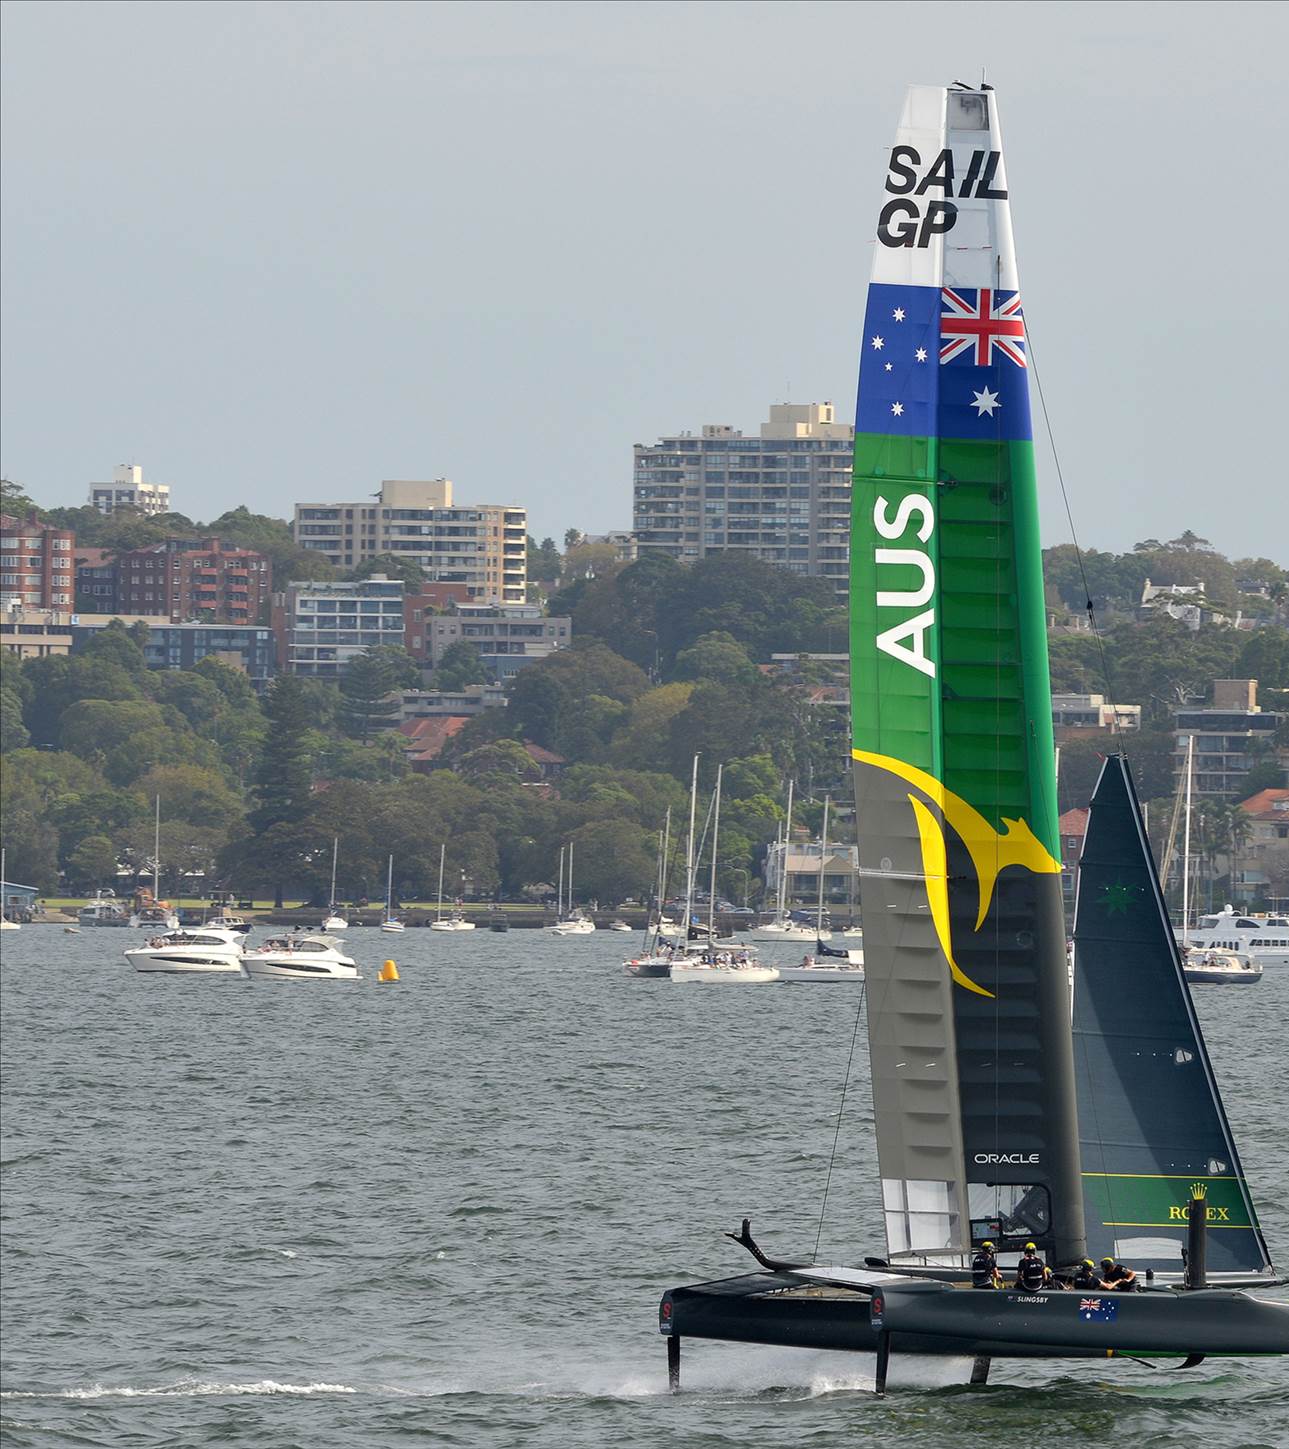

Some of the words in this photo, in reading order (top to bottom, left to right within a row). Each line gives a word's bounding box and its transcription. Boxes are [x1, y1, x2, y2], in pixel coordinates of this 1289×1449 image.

[885, 145, 1008, 200] SAIL
[877, 198, 958, 248] GP
[873, 493, 936, 679] AUS
[974, 1153, 1040, 1164] ORACLE
[1168, 1206, 1230, 1221] ROEX
[1016, 1296, 1049, 1304] SLINGSBY
